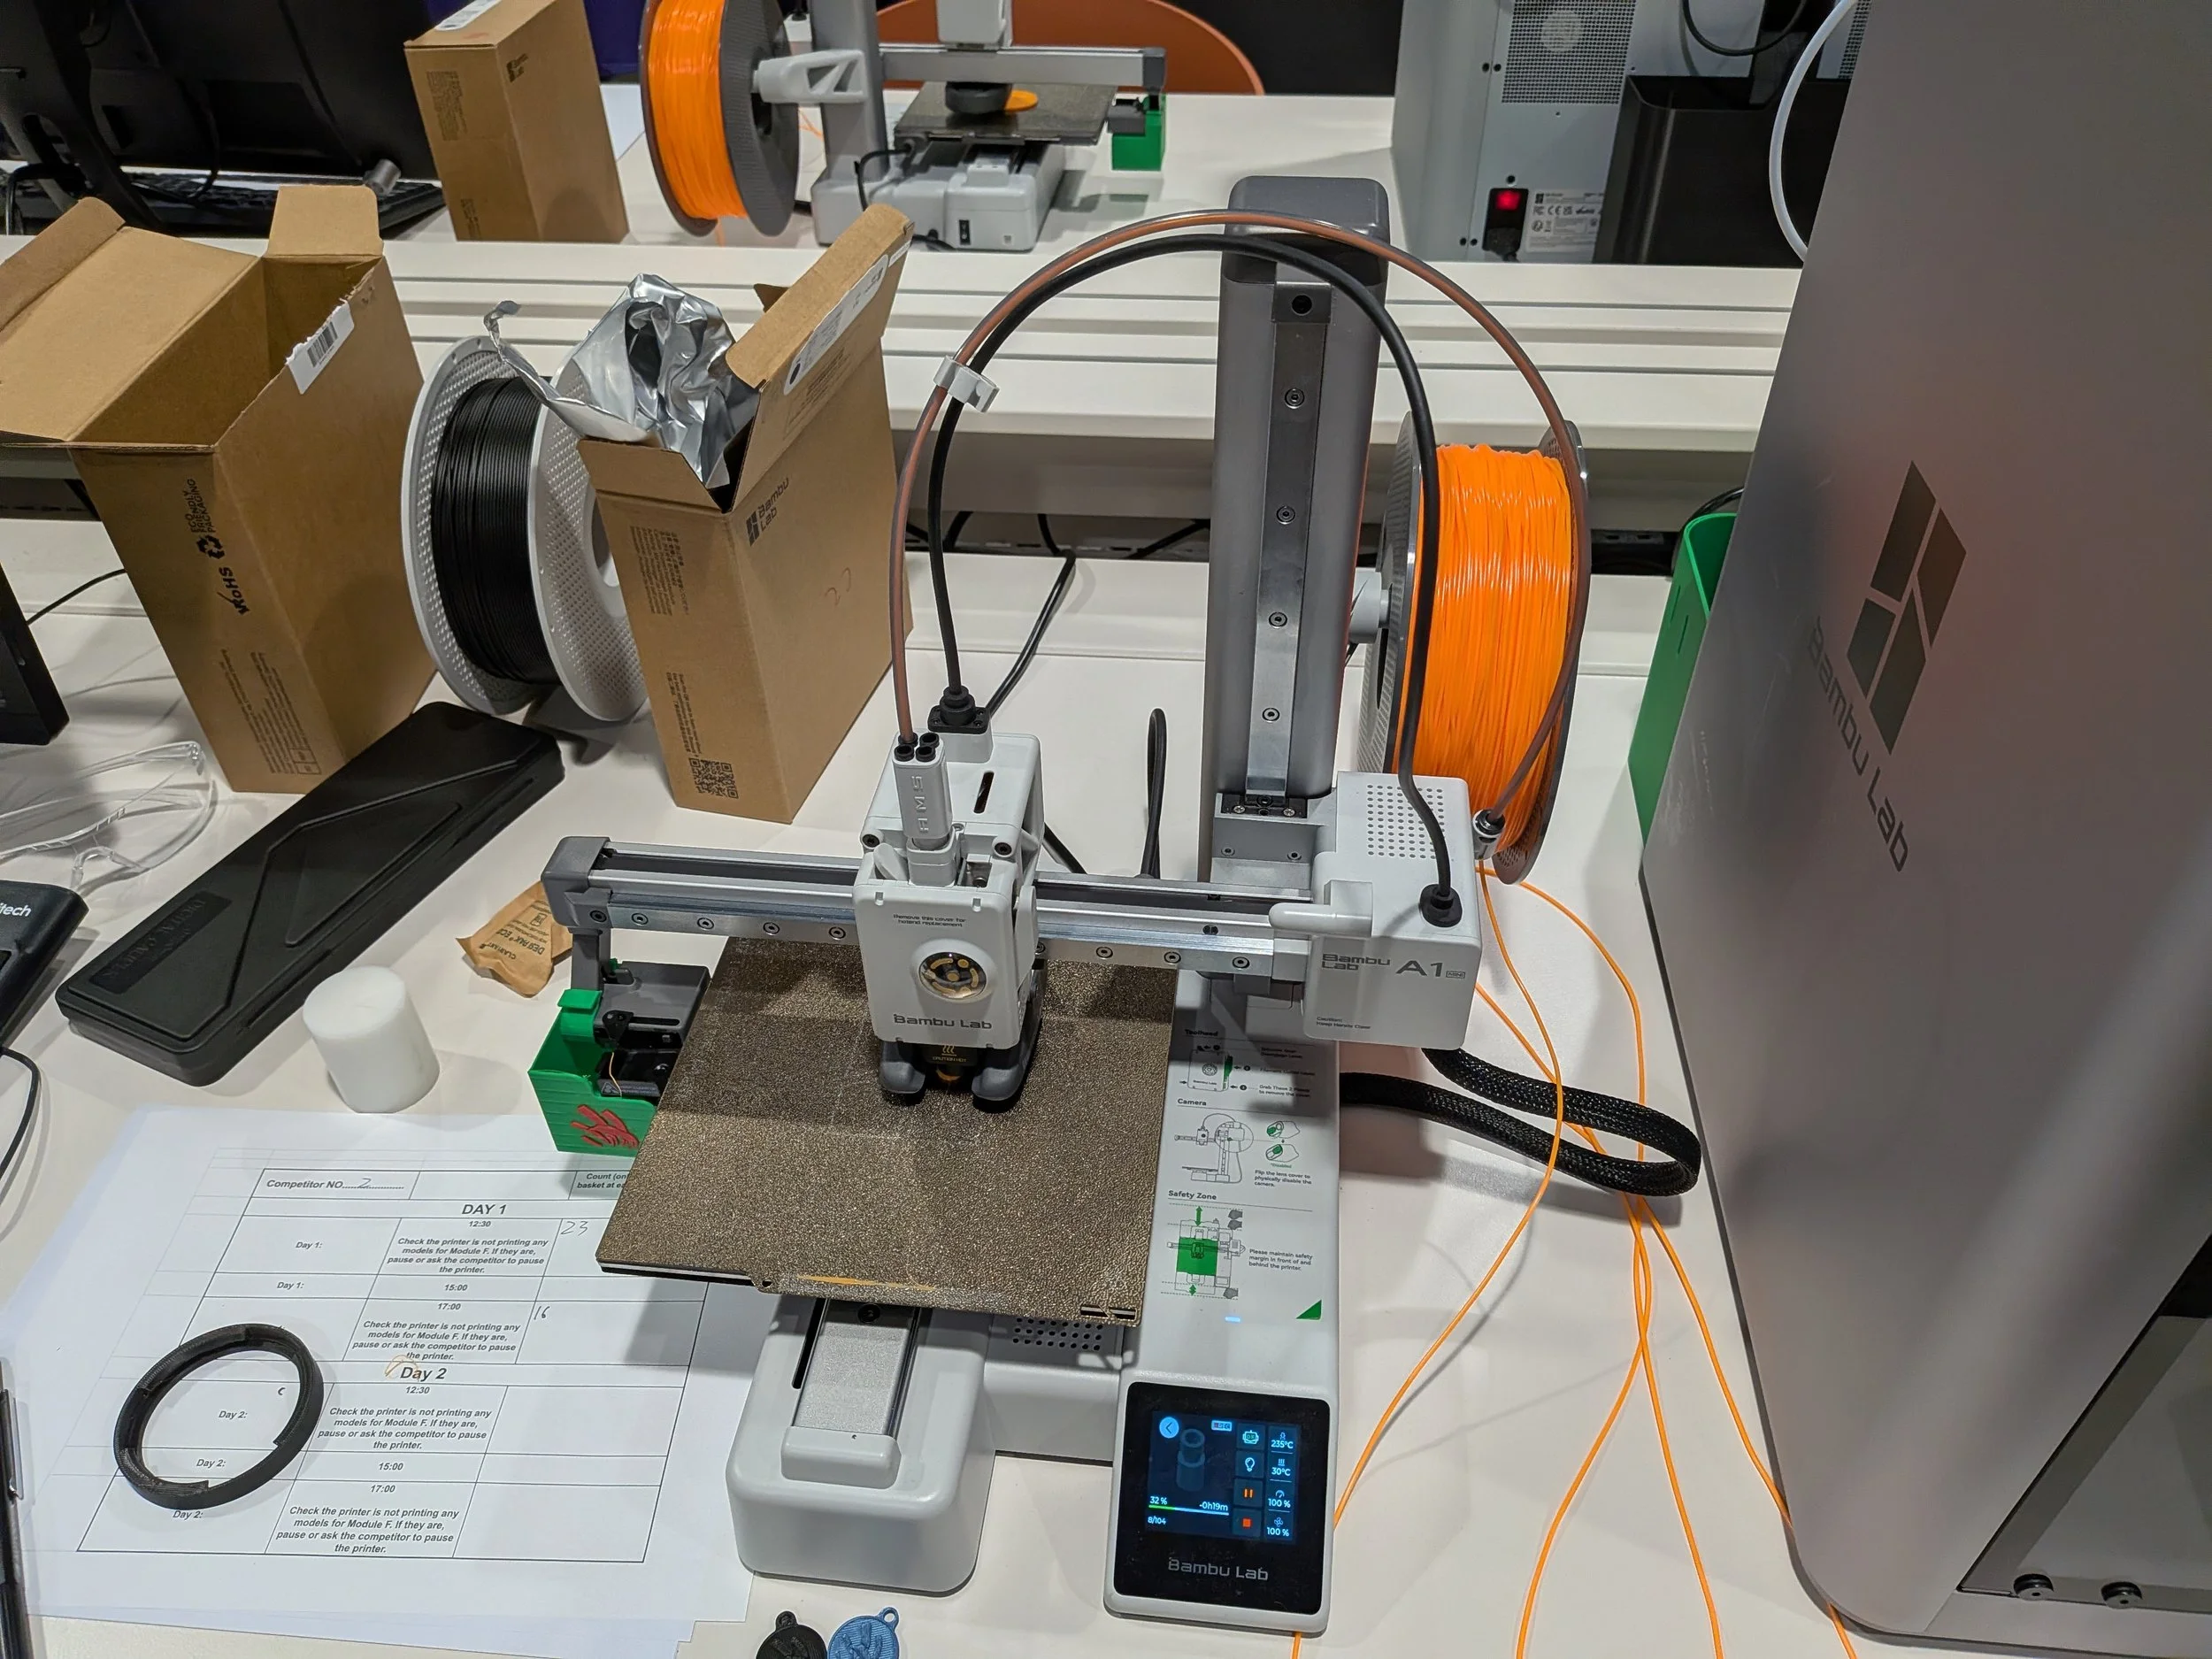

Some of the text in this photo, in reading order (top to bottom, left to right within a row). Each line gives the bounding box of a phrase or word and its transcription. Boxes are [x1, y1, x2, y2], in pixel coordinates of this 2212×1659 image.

[757, 478, 789, 518] Bambu
[188, 478, 216, 532] PACKAGING
[183, 490, 205, 533] FRIENDLY
[185, 514, 197, 532] ECO
[761, 507, 777, 531] Lab
[1808, 616, 1908, 871] Bambu Lab
[911, 775, 929, 833] AMS
[487, 942, 516, 960] CLARIANT
[1322, 953, 1391, 965] Bambu
[1322, 961, 1359, 970] Lab
[1395, 960, 1443, 977] A1
[893, 1014, 992, 1029] Bambu Lab
[267, 1179, 325, 1190] Competitor
[1168, 1190, 1195, 1199] Safety
[462, 1204, 507, 1215] DAY 1
[561, 1220, 589, 1236] 23
[277, 1282, 294, 1290] Day
[401, 1366, 447, 1382] Day 2
[218, 1411, 247, 1420] Day 2:
[436, 1409, 472, 1418] printing
[440, 1420, 458, 1429] they
[395, 1431, 444, 1439] competitor
[390, 1442, 422, 1450] printer.
[196, 1459, 226, 1469] Day 2:
[1150, 1496, 1159, 1504] 32
[1268, 1498, 1291, 1508] 100 %
[1199, 1501, 1228, 1511] -0h19m
[172, 1510, 203, 1519] Day 2:
[339, 1508, 370, 1517] printer
[401, 1509, 438, 1519] printing
[441, 1510, 459, 1519] any
[331, 1519, 345, 1527] for
[347, 1520, 382, 1528] Module
[395, 1520, 402, 1528] If
[404, 1521, 424, 1530] they
[1147, 1516, 1166, 1525] 8/104
[1267, 1527, 1281, 1535] 100
[358, 1532, 410, 1542] competitor
[335, 1544, 386, 1554] the printer.
[1168, 1557, 1268, 1580] Bambu Lab
